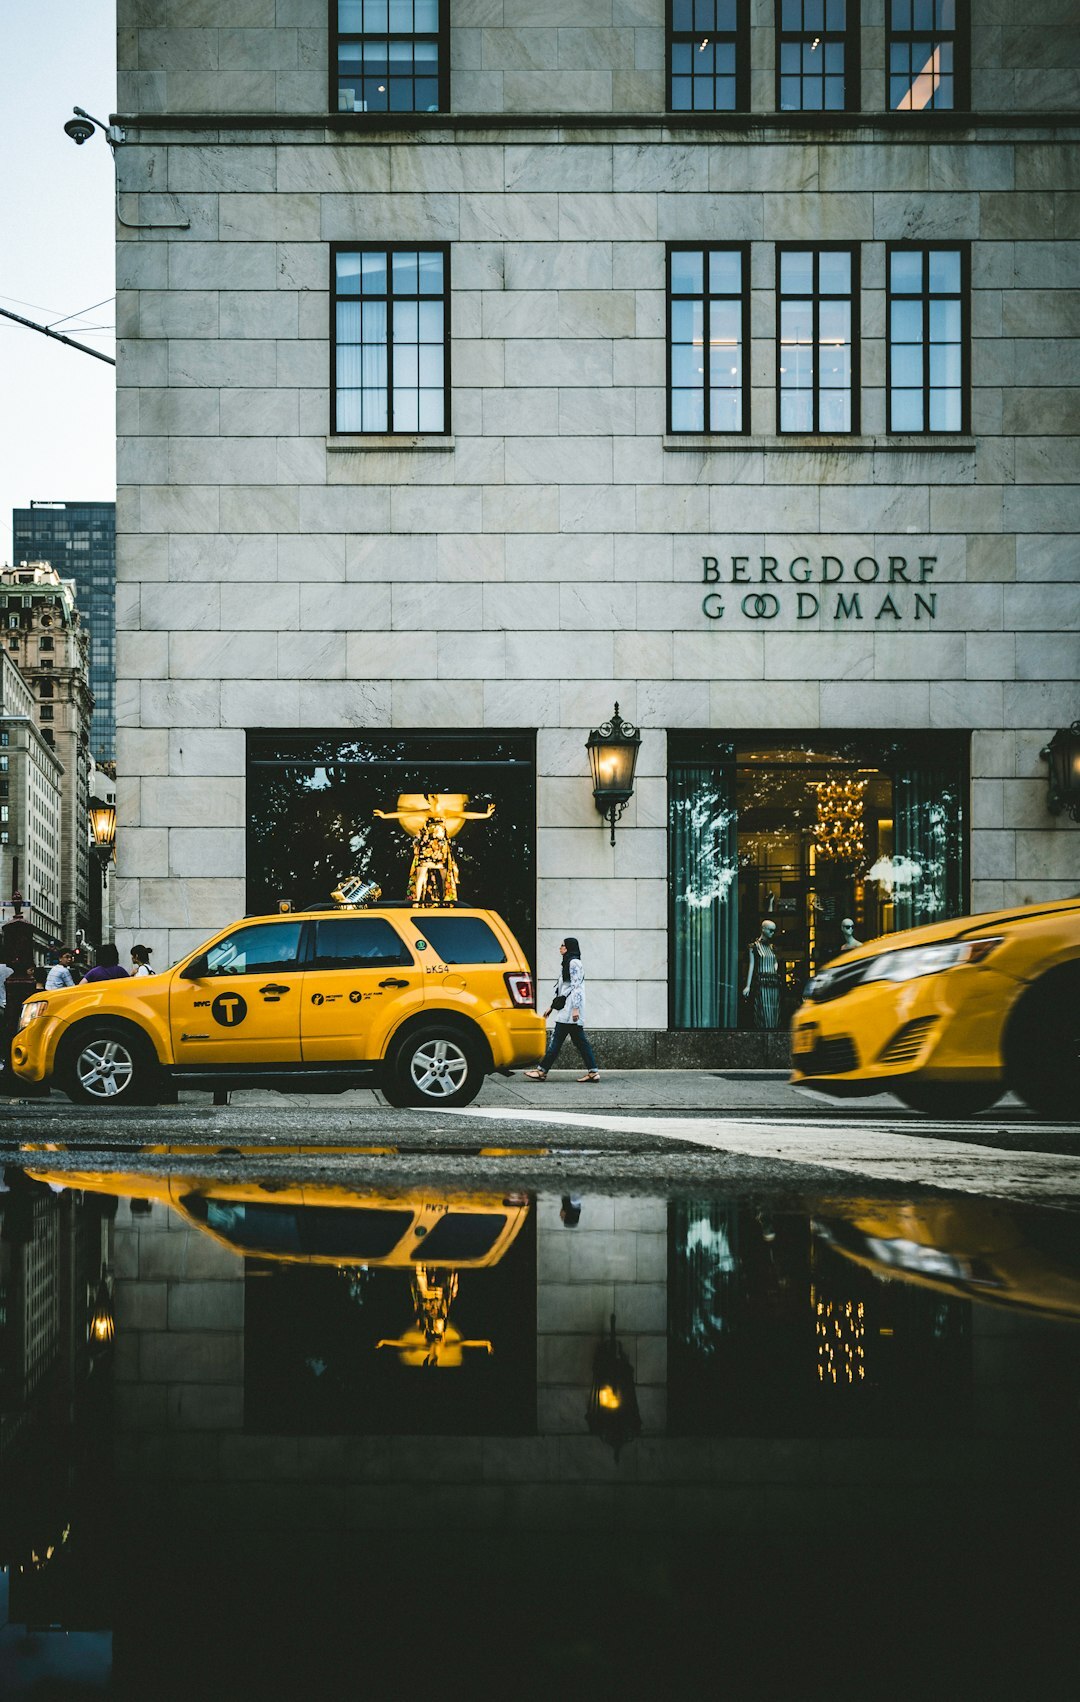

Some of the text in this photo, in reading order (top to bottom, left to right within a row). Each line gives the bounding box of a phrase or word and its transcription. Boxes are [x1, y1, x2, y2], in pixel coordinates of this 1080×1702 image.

[702, 556, 938, 583] BERGDORF
[701, 592, 937, 620] GOODMAN
[219, 998, 239, 1023] T
